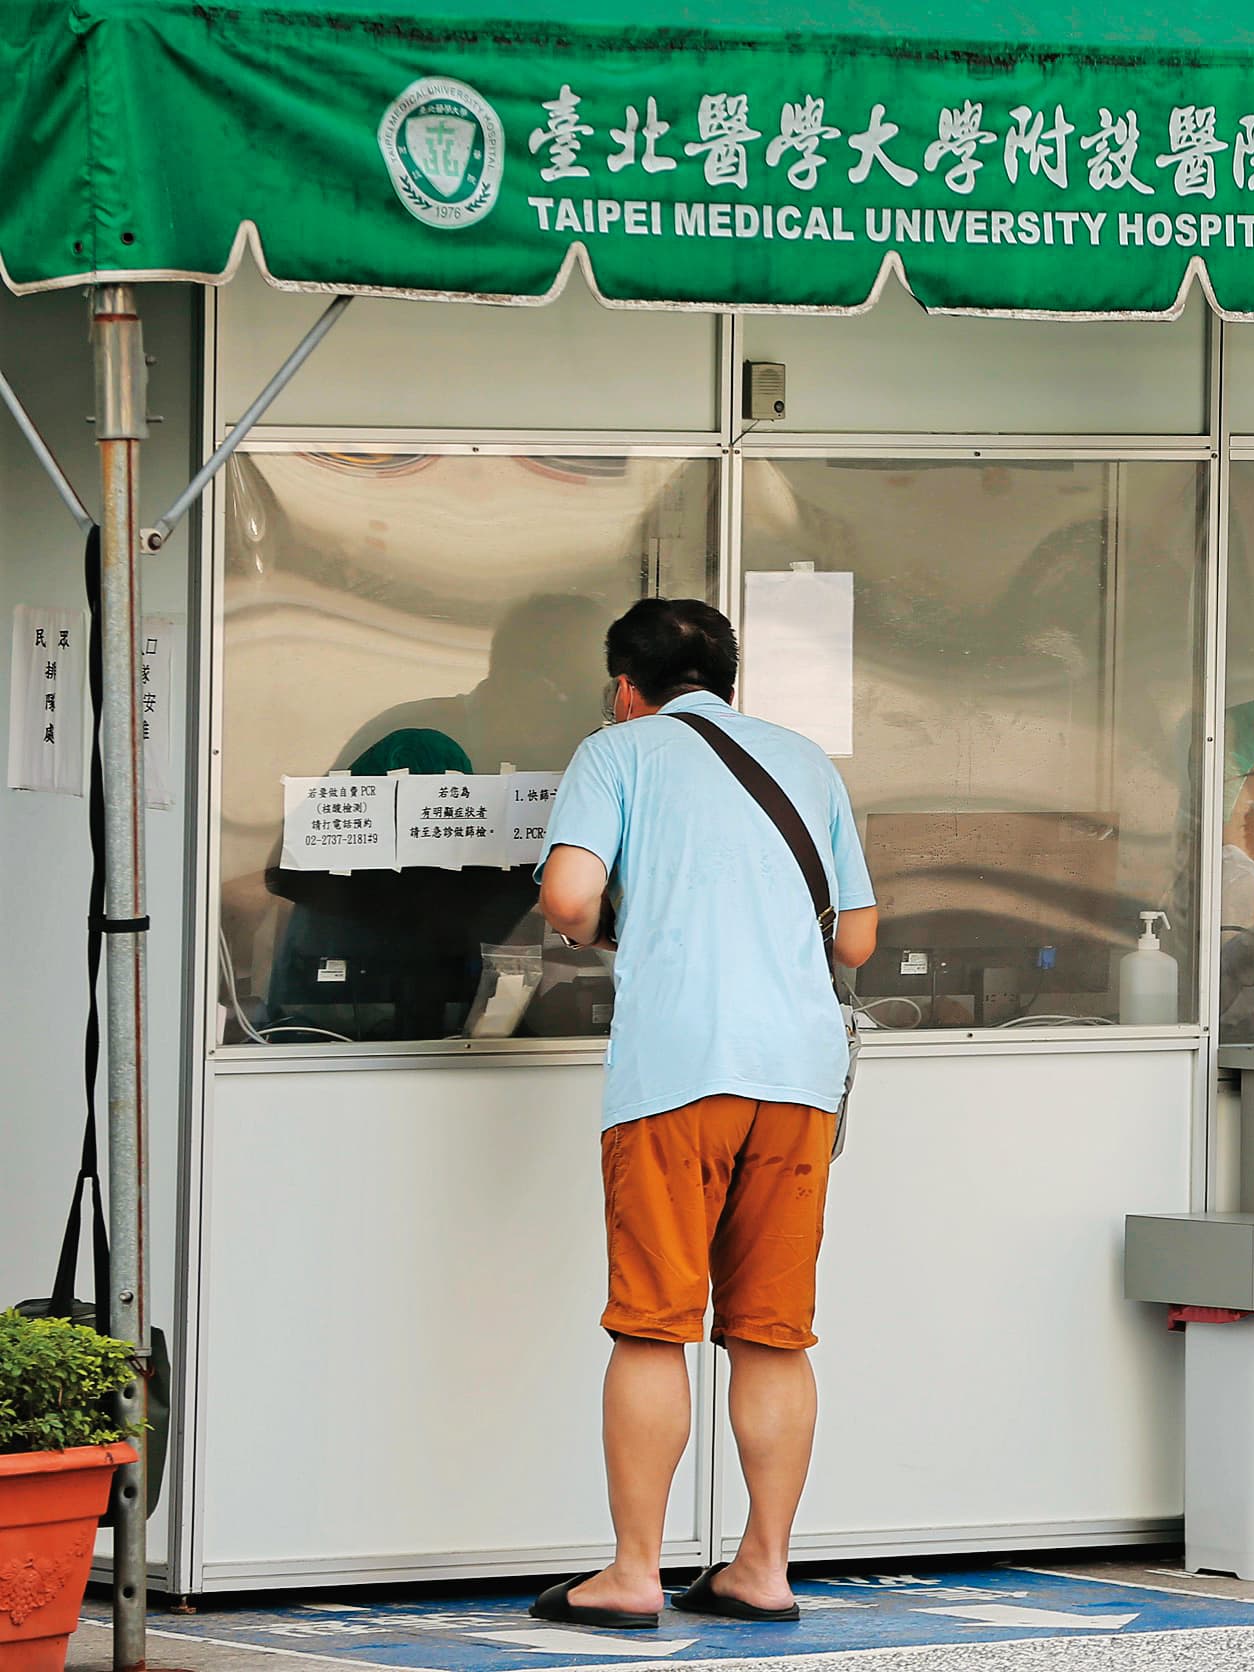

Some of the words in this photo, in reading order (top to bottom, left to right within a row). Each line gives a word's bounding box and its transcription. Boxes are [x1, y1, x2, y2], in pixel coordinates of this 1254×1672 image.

[436, 206, 462, 219] 1976
[527, 196, 663, 236] TAIPEI
[674, 202, 855, 241] MEDICAL
[866, 207, 1108, 246] UNIVERSITY
